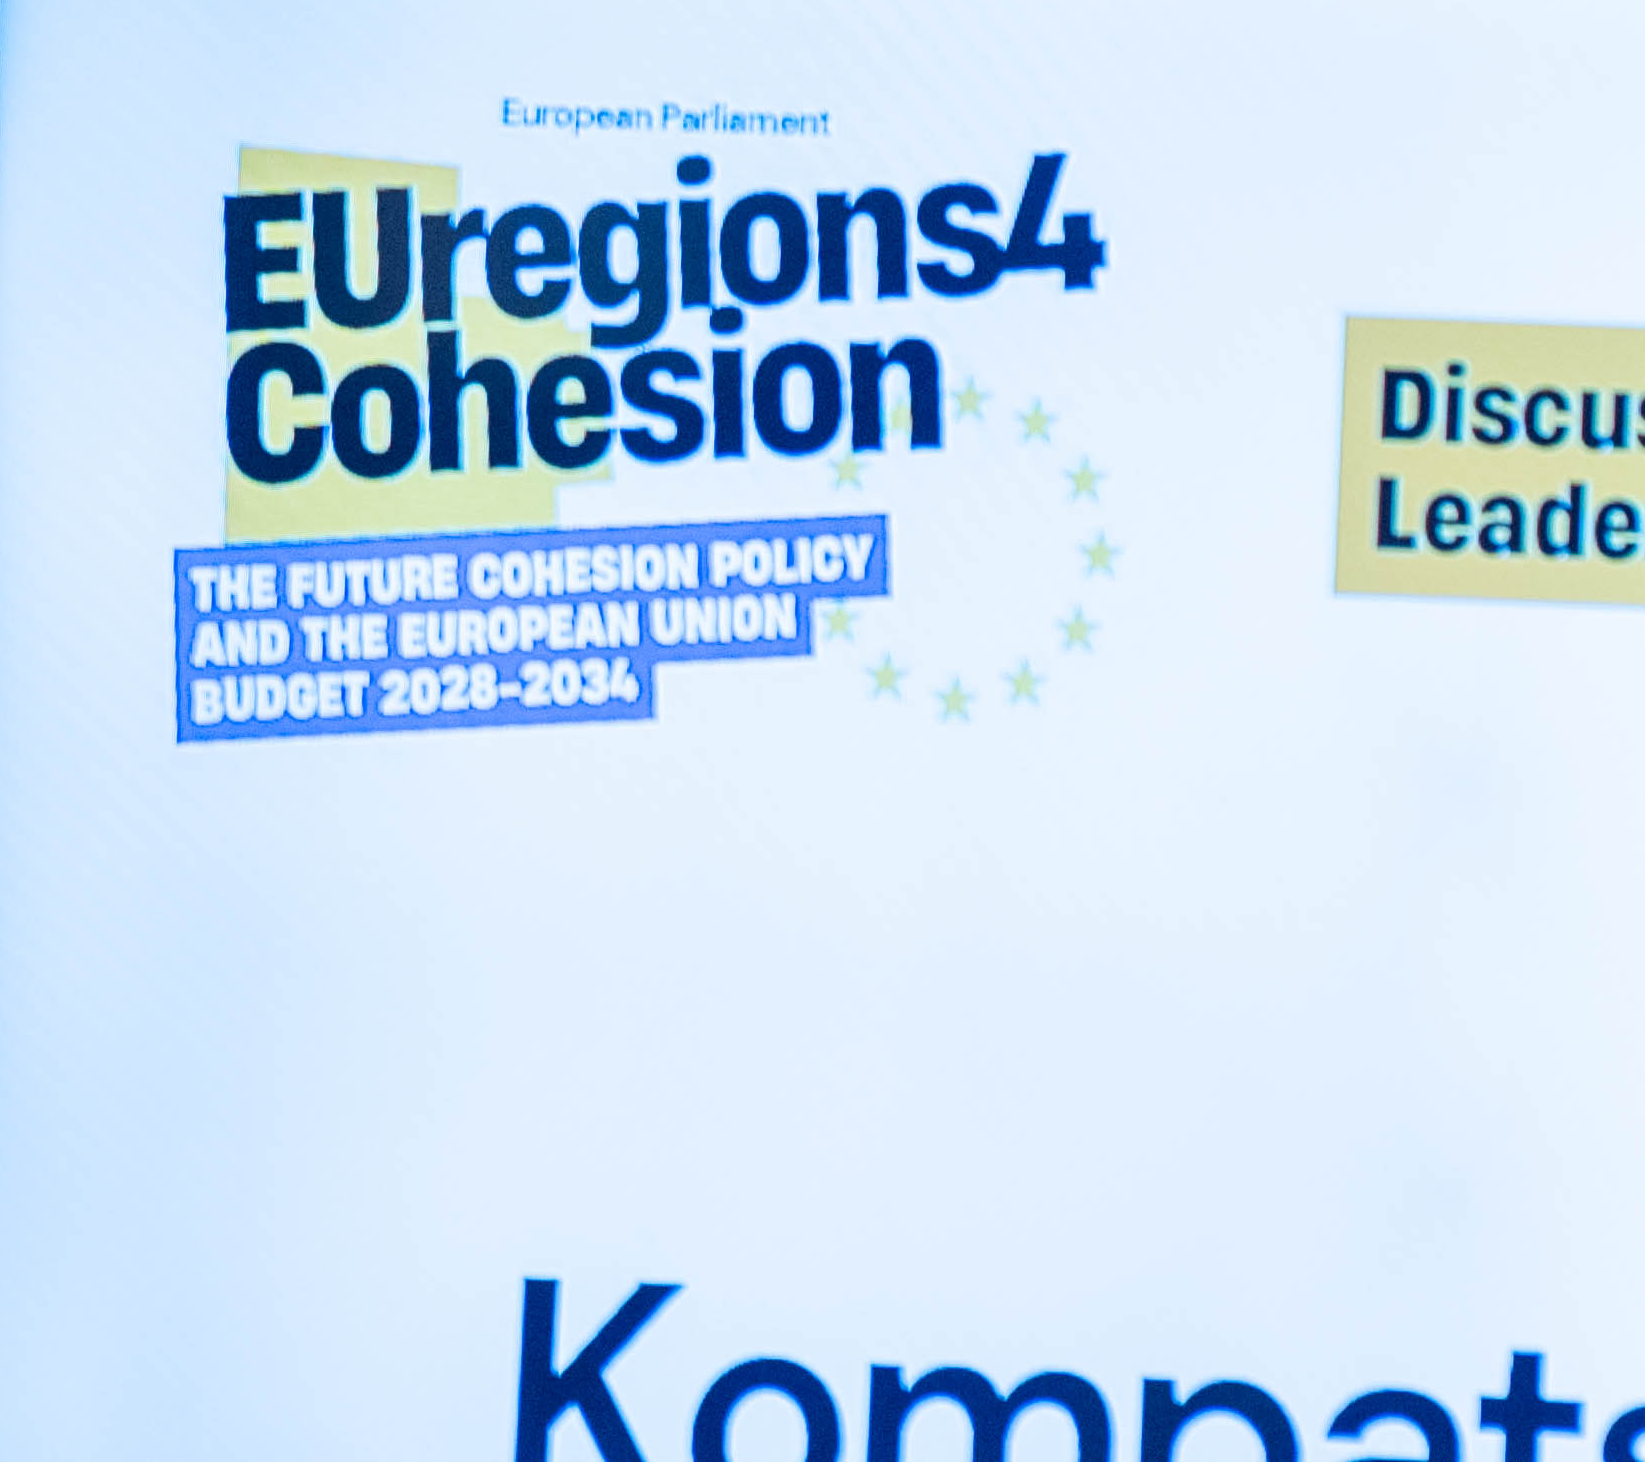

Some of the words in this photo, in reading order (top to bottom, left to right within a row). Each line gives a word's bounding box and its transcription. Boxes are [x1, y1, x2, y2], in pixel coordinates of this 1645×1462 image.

[501, 96, 655, 133] European
[660, 102, 831, 135] Parliament
[223, 153, 1107, 349] EUregions4
[225, 308, 943, 483] Cohesion
[190, 565, 277, 613] THE
[287, 554, 459, 609] FUTURE
[471, 542, 699, 600] COHESION
[708, 534, 875, 587] POLICY
[191, 621, 290, 667] AND
[301, 616, 389, 662] THE
[397, 602, 639, 658] EUROPEAN
[655, 594, 796, 645] UNION
[191, 671, 370, 726] BUDGET
[379, 657, 639, 717] 2028-2034
